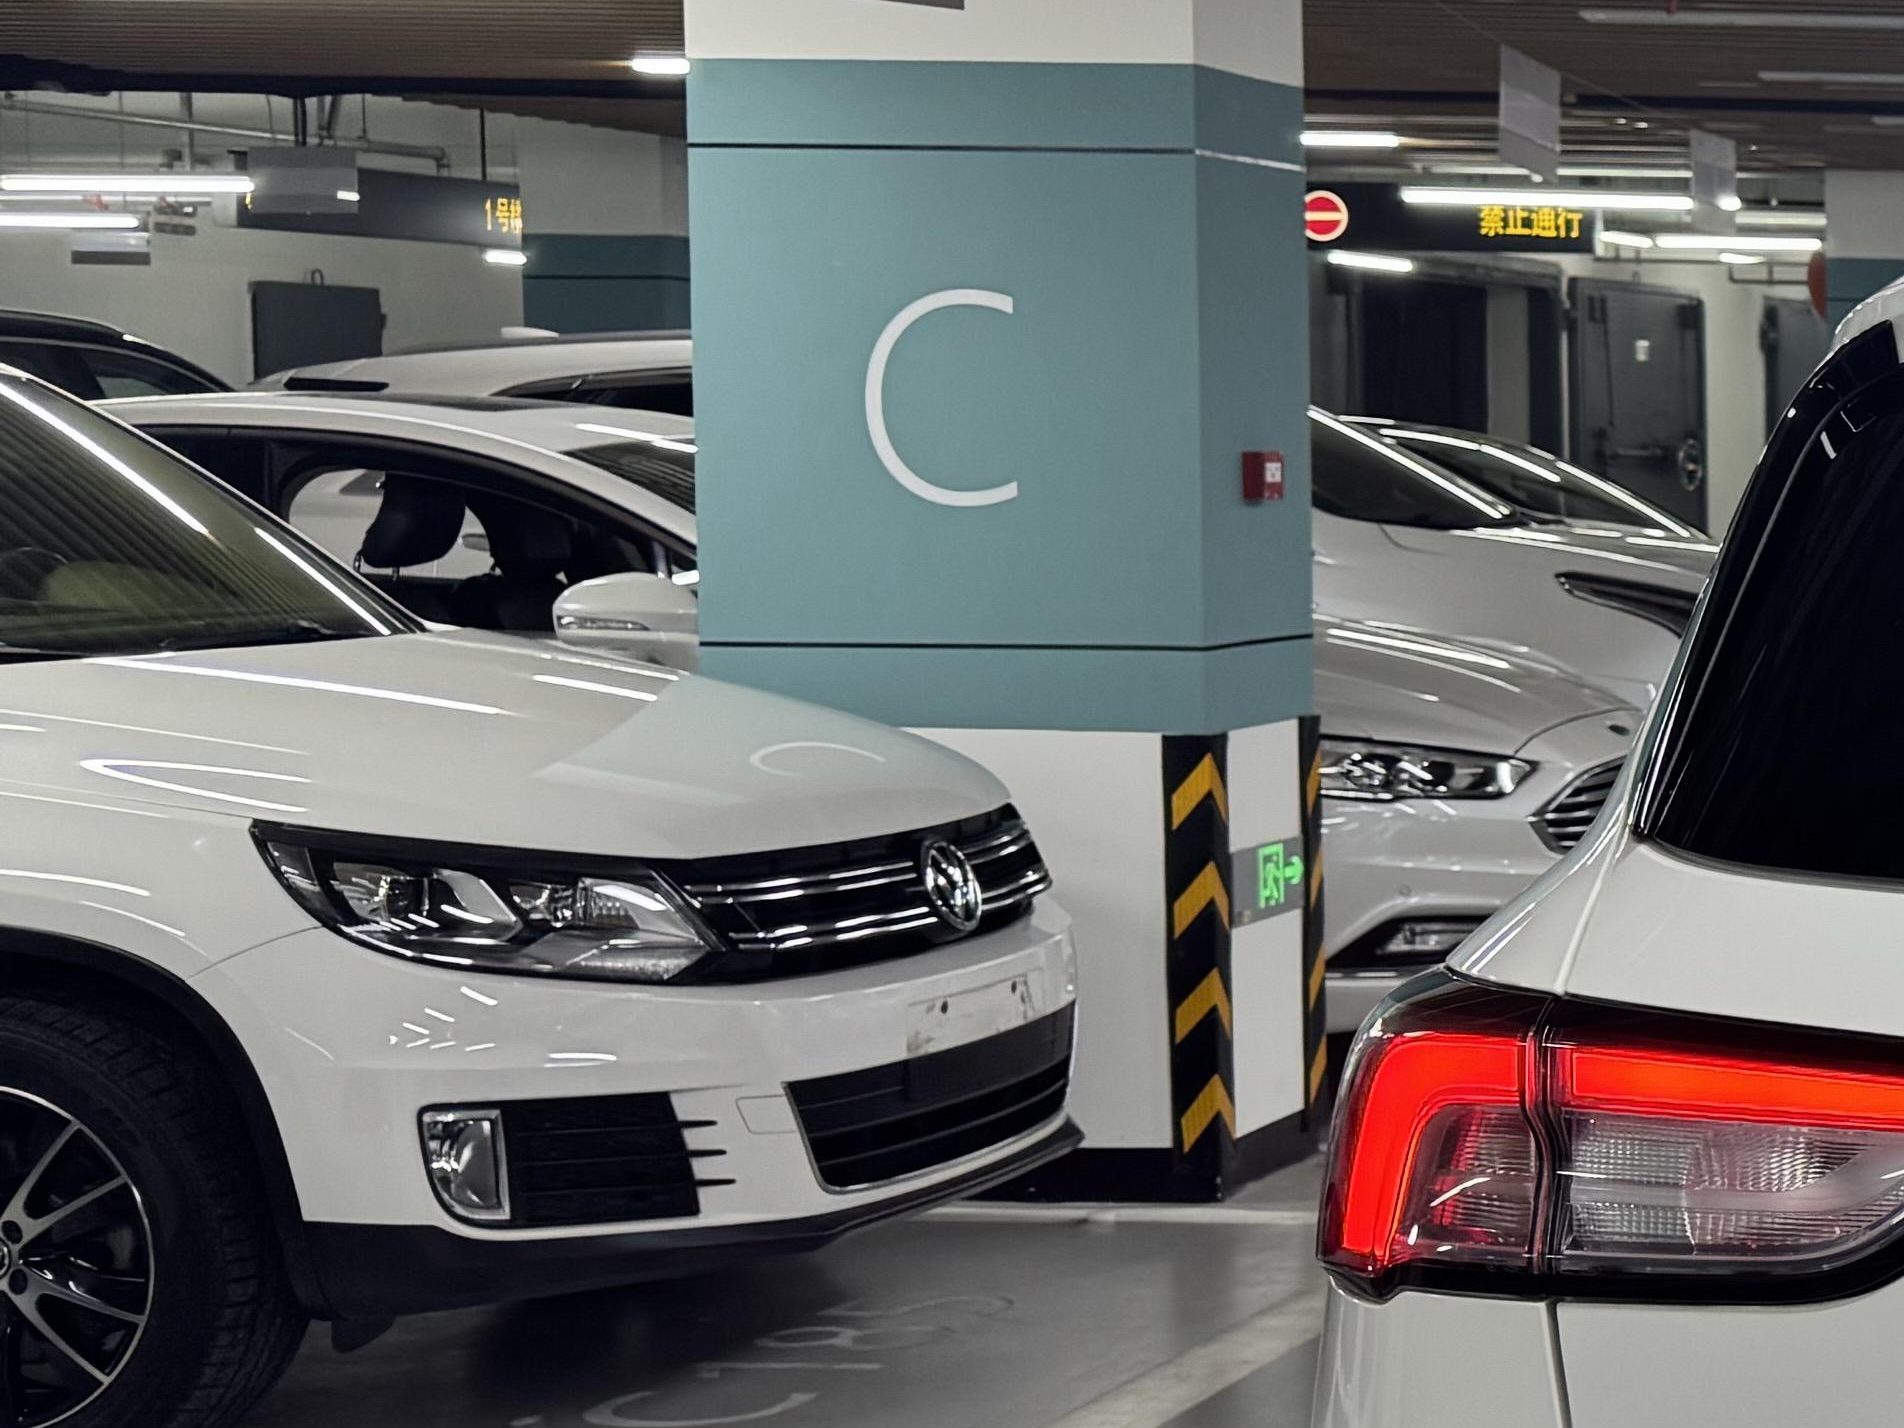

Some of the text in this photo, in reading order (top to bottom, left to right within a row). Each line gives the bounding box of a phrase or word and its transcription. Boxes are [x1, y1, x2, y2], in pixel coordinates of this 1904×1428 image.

[1479, 203, 1583, 238] 禁止通行
[865, 288, 1019, 508] C
